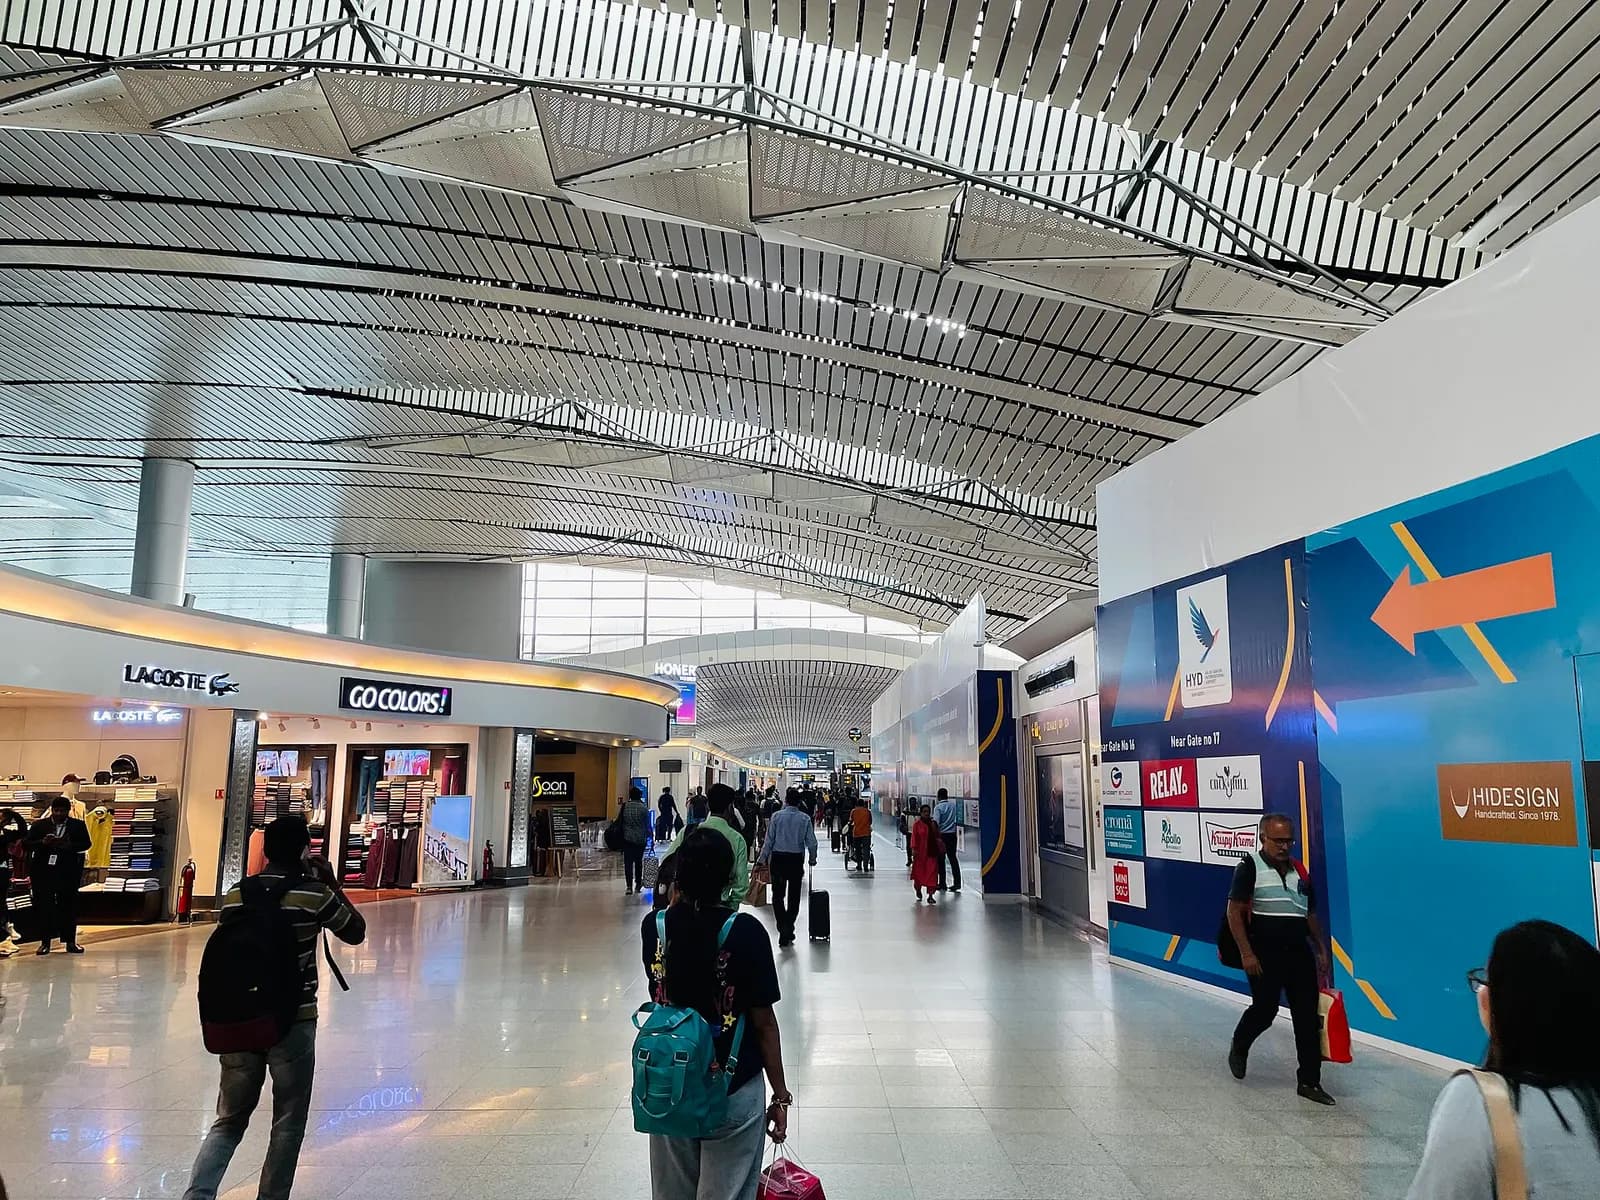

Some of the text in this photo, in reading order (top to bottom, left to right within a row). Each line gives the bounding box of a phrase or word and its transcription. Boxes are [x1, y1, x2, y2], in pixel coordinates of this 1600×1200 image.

[124, 664, 206, 690] LACOSTE
[654, 661, 698, 677] HONER
[1186, 672, 1203, 688] HYD
[349, 685, 448, 714] GO COLORS!
[93, 710, 153, 722] LACOSTE
[1109, 740, 1120, 752] Gate
[1170, 731, 1220, 748] Near Gate no 17
[1472, 787, 1560, 808] HIDESIGN
[1518, 811, 1539, 820] Since
[1540, 811, 1561, 822] 1978.
[1161, 832, 1182, 845] Apollo
[1211, 830, 1256, 849] Krispy Kreme
[1115, 873, 1128, 884] MINI
